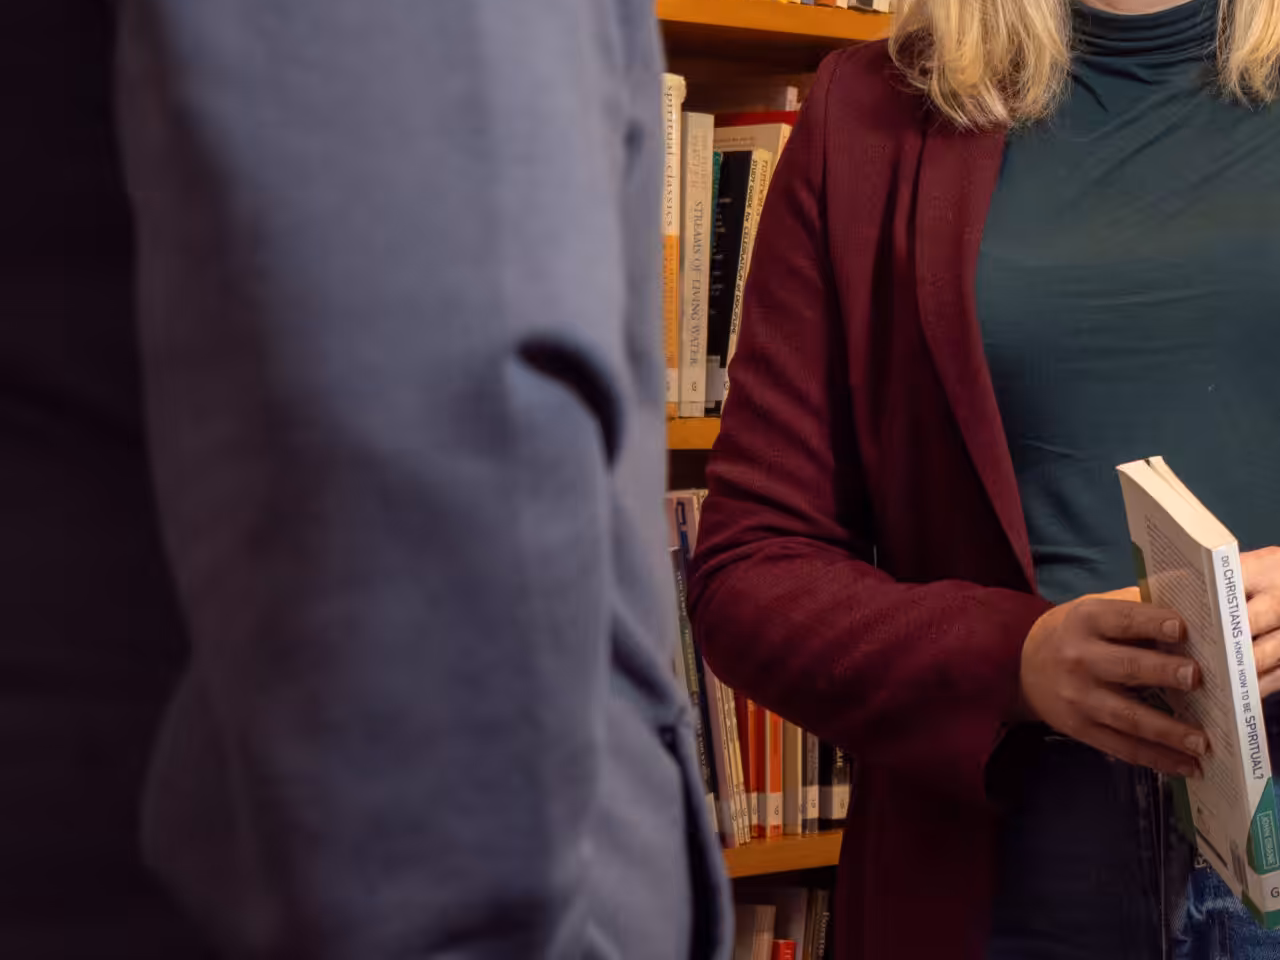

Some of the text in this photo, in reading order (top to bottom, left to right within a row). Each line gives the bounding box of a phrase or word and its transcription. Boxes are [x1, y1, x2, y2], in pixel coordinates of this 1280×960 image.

[664, 85, 674, 155] spiritual
[750, 159, 758, 183] STUDY
[666, 164, 677, 227] classics
[692, 200, 705, 256] STREAMS
[690, 257, 702, 275] OF
[737, 224, 750, 283] CELEBRATION
[690, 279, 702, 321] LIVING
[731, 294, 741, 336] DISCIPLINE
[689, 323, 701, 368] WATER
[1221, 555, 1265, 781] DO CHRISTIANS KNOW HOW TO BE SPIRITUAL?
[1270, 886, 1280, 899] G
